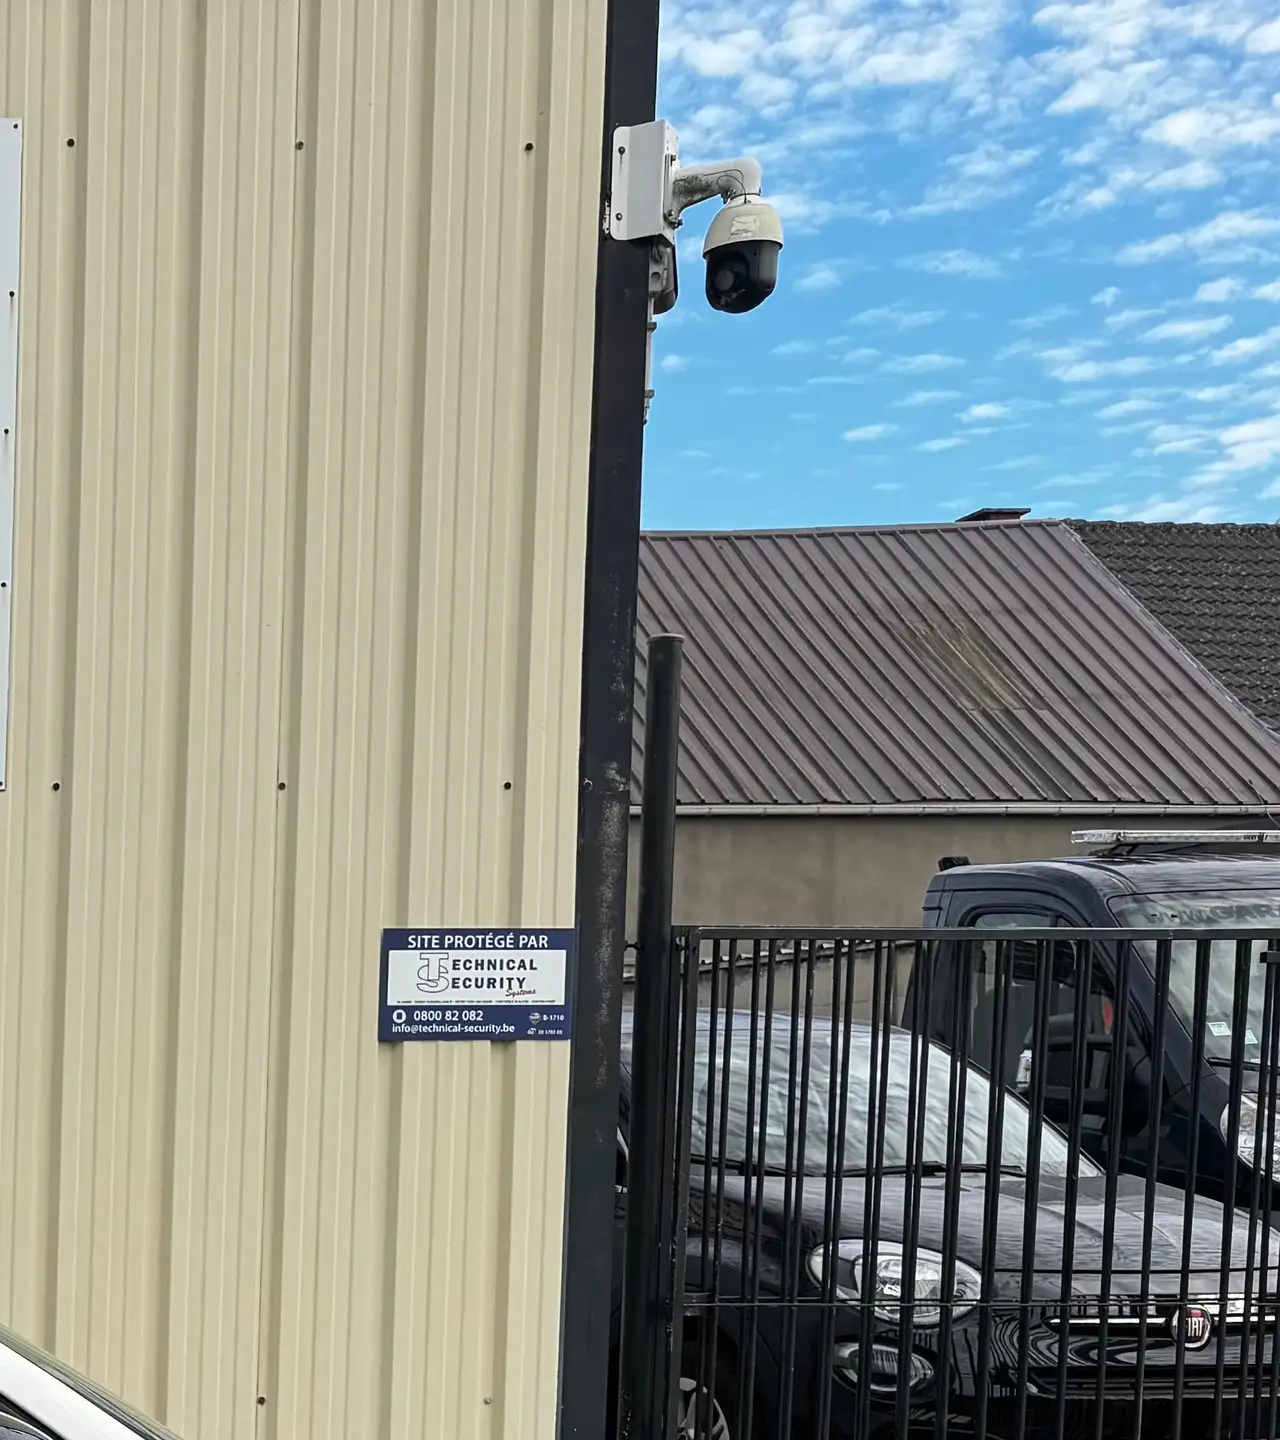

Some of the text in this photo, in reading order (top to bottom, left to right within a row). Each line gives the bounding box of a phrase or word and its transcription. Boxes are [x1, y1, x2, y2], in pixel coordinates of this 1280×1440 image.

[407, 932, 549, 949] SITE PROTÉGÉ PAR
[413, 1010, 483, 1021] 0800 82 082
[392, 1023, 516, 1035] info@technical-security.be
